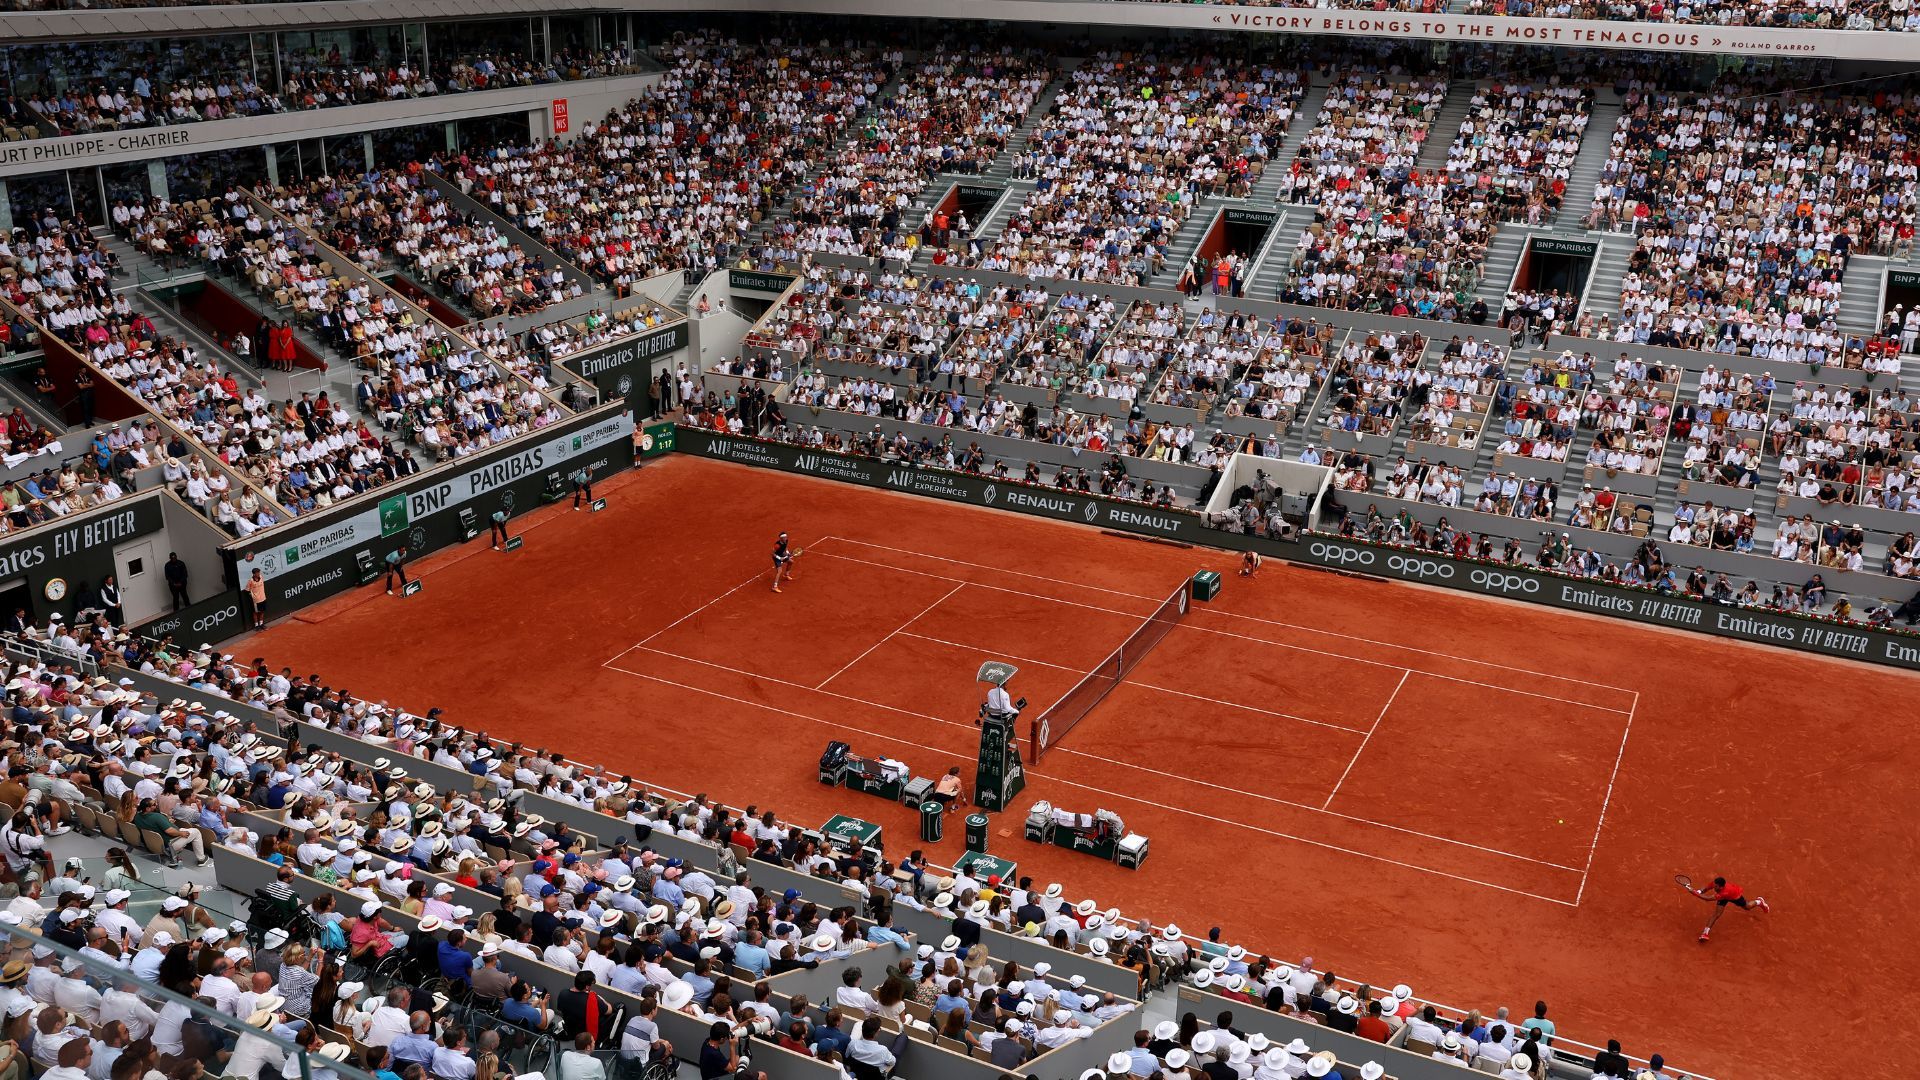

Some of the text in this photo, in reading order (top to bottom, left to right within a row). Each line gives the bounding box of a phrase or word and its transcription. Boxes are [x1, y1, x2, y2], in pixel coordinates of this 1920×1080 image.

[1230, 13, 1312, 28] VICTORY
[1323, 18, 1411, 32] BELONGS
[1423, 22, 1446, 34] TO
[1457, 24, 1494, 37] THE
[1506, 27, 1562, 40] MOST
[1573, 29, 1700, 46] TENACIOUS
[1731, 41, 1817, 52] ROLAND GARROS
[554, 104, 566, 114] TEN
[555, 118, 567, 129] NIS
[33, 139, 105, 160] PHILIPPE
[118, 130, 189, 150] CHATRIER
[1229, 211, 1245, 219] BNP
[1536, 241, 1592, 253] BNP PARIBAS
[731, 274, 766, 288] Emirates
[1894, 274, 1916, 283] BNP
[581, 330, 676, 377] Emirates FLY BETTER
[583, 431, 595, 443] BNP
[732, 450, 779, 465] EXPERIENCES
[733, 442, 760, 453] HOTELS
[582, 457, 608, 475] PRIBAS
[822, 457, 851, 468] HOTELS
[411, 447, 543, 518] BNP PARIBAS
[820, 465, 870, 481] EXPERIENCES
[916, 473, 946, 485] HOTELS
[914, 482, 968, 498] EXPERIENCES
[1007, 491, 1076, 513] RENAULT
[1109, 509, 1182, 532] RENAULT
[54, 528, 78, 559] FLY
[84, 510, 136, 549] BETTER
[300, 525, 354, 554] BNP PARIBAS
[1309, 542, 1375, 565] oppo
[1387, 555, 1455, 578] oppo
[284, 567, 343, 599] BNP PARIBAS
[1470, 569, 1540, 593] oppo
[1561, 585, 1702, 625] Emirates FLY BETTER
[192, 605, 238, 632] oppo
[1717, 612, 1920, 663] Emirates FLY BETTER Em
